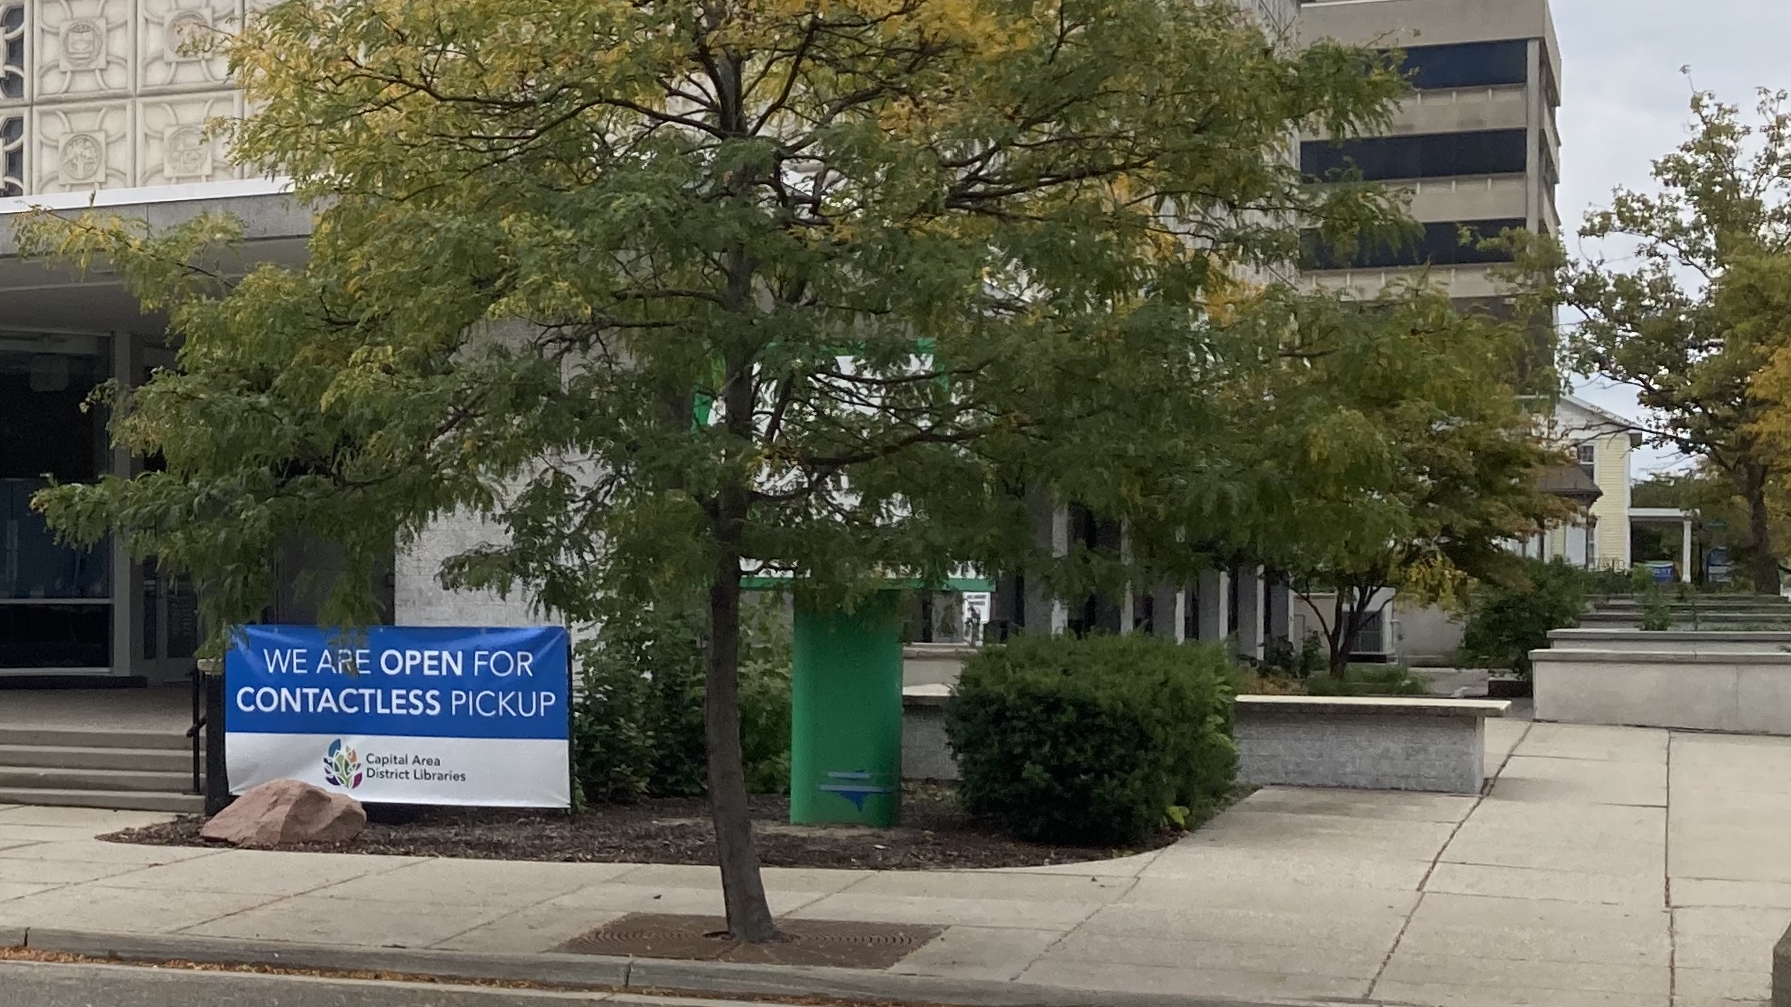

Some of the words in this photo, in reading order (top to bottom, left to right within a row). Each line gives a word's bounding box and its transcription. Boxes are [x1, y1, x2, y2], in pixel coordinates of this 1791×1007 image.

[263, 648, 308, 674] WE
[316, 649, 372, 675] ARE
[380, 649, 463, 676] OPEN
[474, 650, 533, 677] FOR
[236, 686, 441, 716] CONTACTLESS
[451, 690, 556, 717] PICKUP
[366, 753, 408, 767] Capital
[412, 754, 441, 766] Area
[366, 767, 410, 780] District
[413, 769, 466, 782] Libraries
